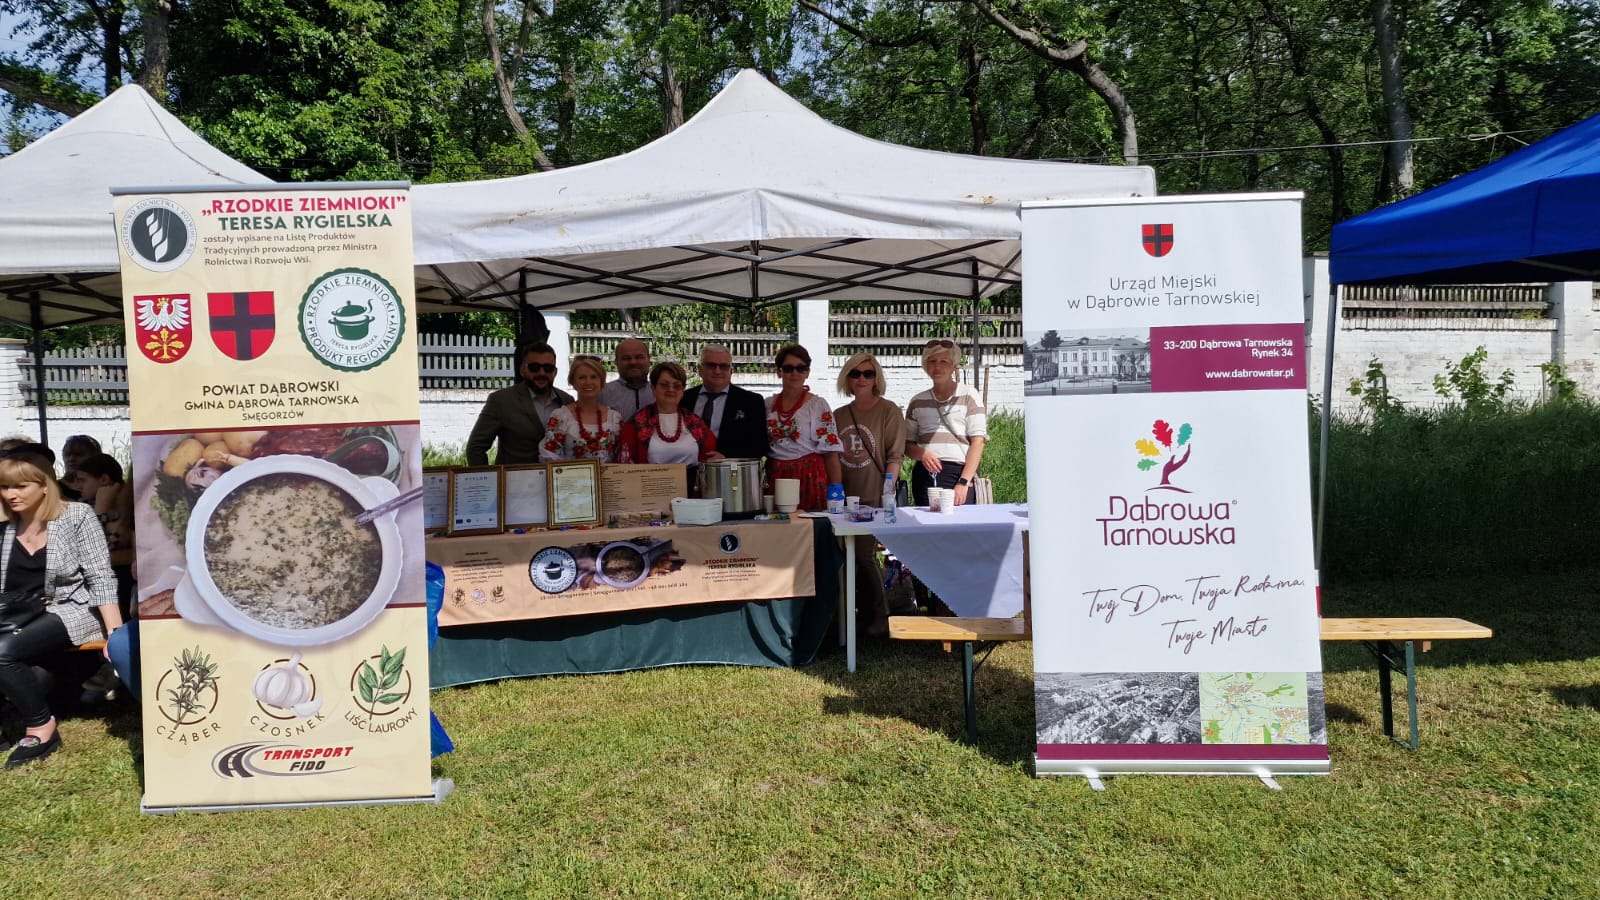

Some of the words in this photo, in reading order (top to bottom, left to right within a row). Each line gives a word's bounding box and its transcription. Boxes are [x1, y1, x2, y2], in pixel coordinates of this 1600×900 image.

[201, 198, 294, 216] „RZODKIE
[218, 216, 287, 231] TERESA
[293, 213, 392, 229] RYGIELSKA
[203, 234, 234, 245] zostały
[236, 234, 272, 244] wpisane
[286, 233, 306, 242] Listę
[308, 232, 355, 241] Produktów
[203, 246, 260, 256] Tradycyjnych
[262, 244, 315, 255] prowadzoną
[317, 244, 340, 253] przez
[342, 243, 377, 251] Ministra
[204, 257, 248, 266] Rolnictwa
[254, 256, 292, 266] Rozwoju
[293, 255, 312, 264] Wsi.
[1109, 276, 1157, 294] Urząd
[1161, 273, 1217, 292] Miejski
[307, 279, 340, 317] RZODKIE
[345, 276, 395, 313] ZIEMNIOKI
[1067, 298, 1081, 310] w
[1086, 294, 1160, 311] Dąbrowie
[1166, 290, 1260, 307] Tarnowskiej
[307, 326, 344, 361] PRODUKT
[346, 320, 399, 365] REGIONALNY
[1163, 340, 1197, 350] 33-200
[1199, 339, 1241, 350] Dąbrowa
[1243, 337, 1293, 348] Tarnowska
[1251, 348, 1279, 359] Rynek
[1281, 348, 1293, 357] 34
[1205, 368, 1294, 378] www.dabrowatar.pl
[202, 384, 255, 396] POWIAT
[260, 380, 340, 396] DĄBROWSKI
[184, 400, 225, 411] GMINA
[228, 398, 285, 411] DĄBROWA
[288, 395, 360, 407] TARNOWSKA
[242, 409, 304, 422] SMĘGORZÓW
[1109, 495, 1230, 524] Dąbrowa
[1096, 518, 1236, 546] Tarnowska
[1082, 588, 1119, 623] Twój
[1120, 584, 1184, 616] Dom.
[1185, 575, 1231, 611] Twoja
[1234, 575, 1304, 597] Rodzina.
[1161, 619, 1207, 654] Twoje
[1210, 616, 1269, 644] Miasto
[249, 712, 325, 738] CZOSNEK
[344, 710, 365, 730] LIŚĆ
[368, 707, 419, 734] LAUROWY
[156, 721, 222, 745] CZĄBER
[263, 746, 354, 761] TRANSPORT
[289, 760, 326, 772] FIDO
